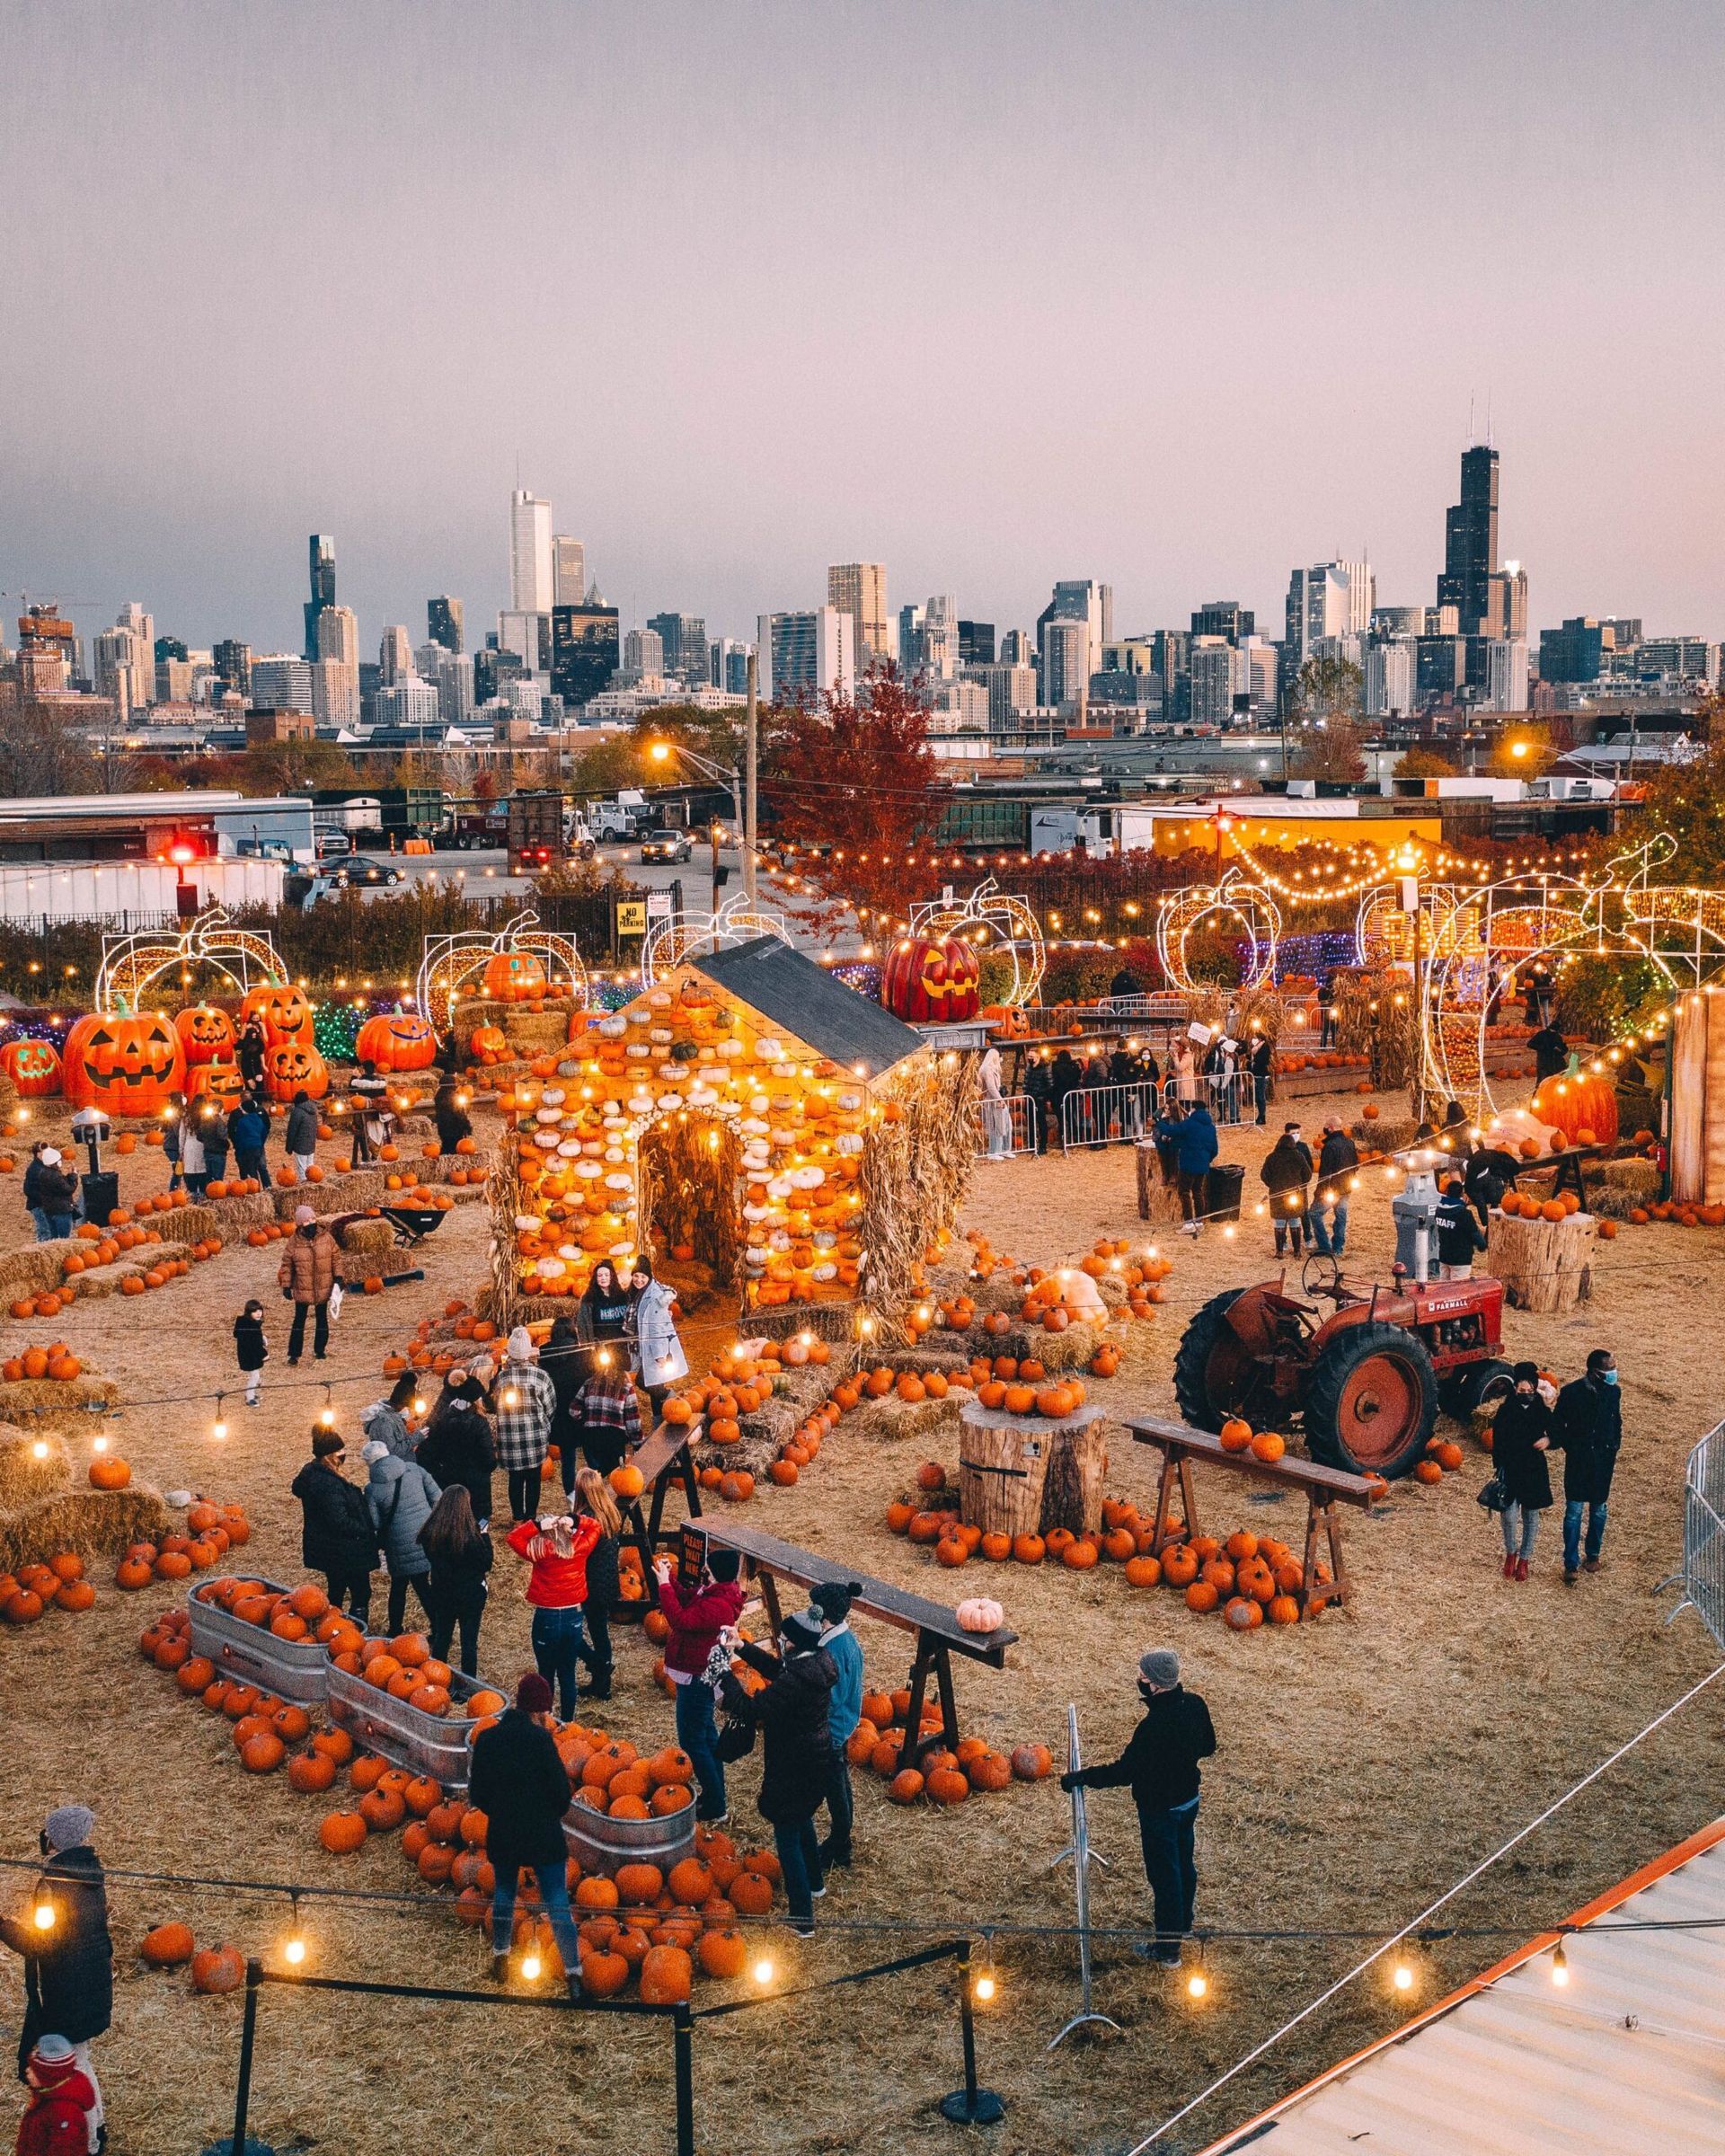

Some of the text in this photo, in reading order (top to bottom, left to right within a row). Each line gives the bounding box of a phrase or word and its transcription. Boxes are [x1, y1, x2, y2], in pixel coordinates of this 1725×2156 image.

[625, 907, 637, 916] NO
[1435, 1217, 1455, 1229] STAFF
[1436, 1300, 1467, 1311] FARMALL
[683, 1533, 703, 1551] PLEASE
[686, 1546, 701, 1562] WAIT
